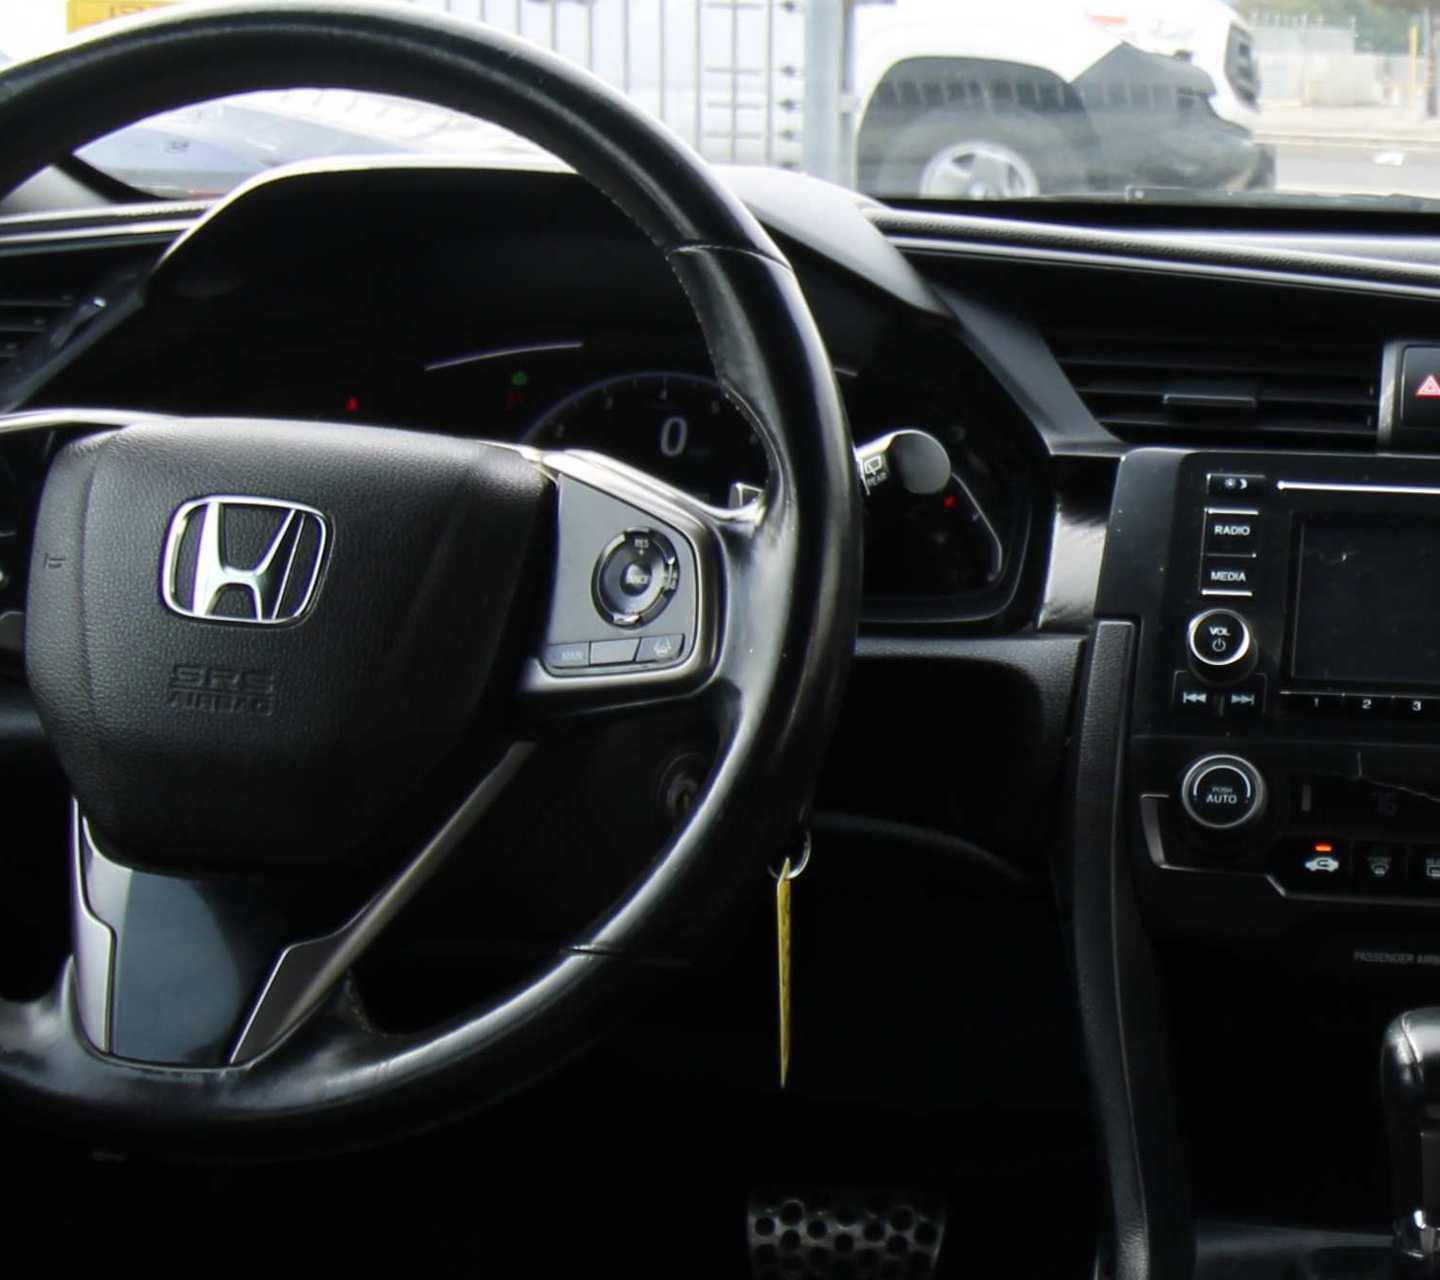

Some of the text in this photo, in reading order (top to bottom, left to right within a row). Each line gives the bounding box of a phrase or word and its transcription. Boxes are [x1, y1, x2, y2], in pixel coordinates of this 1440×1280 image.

[660, 415, 688, 458] 0
[1214, 524, 1250, 536] RADIO
[1210, 570, 1247, 582] MEDIA
[1209, 626, 1231, 636] VOL
[1313, 697, 1320, 707] 1
[1361, 698, 1372, 709] 2
[1411, 700, 1422, 711] 3
[1206, 793, 1238, 805] AUTO
[1353, 951, 1415, 963] PASSENGER
